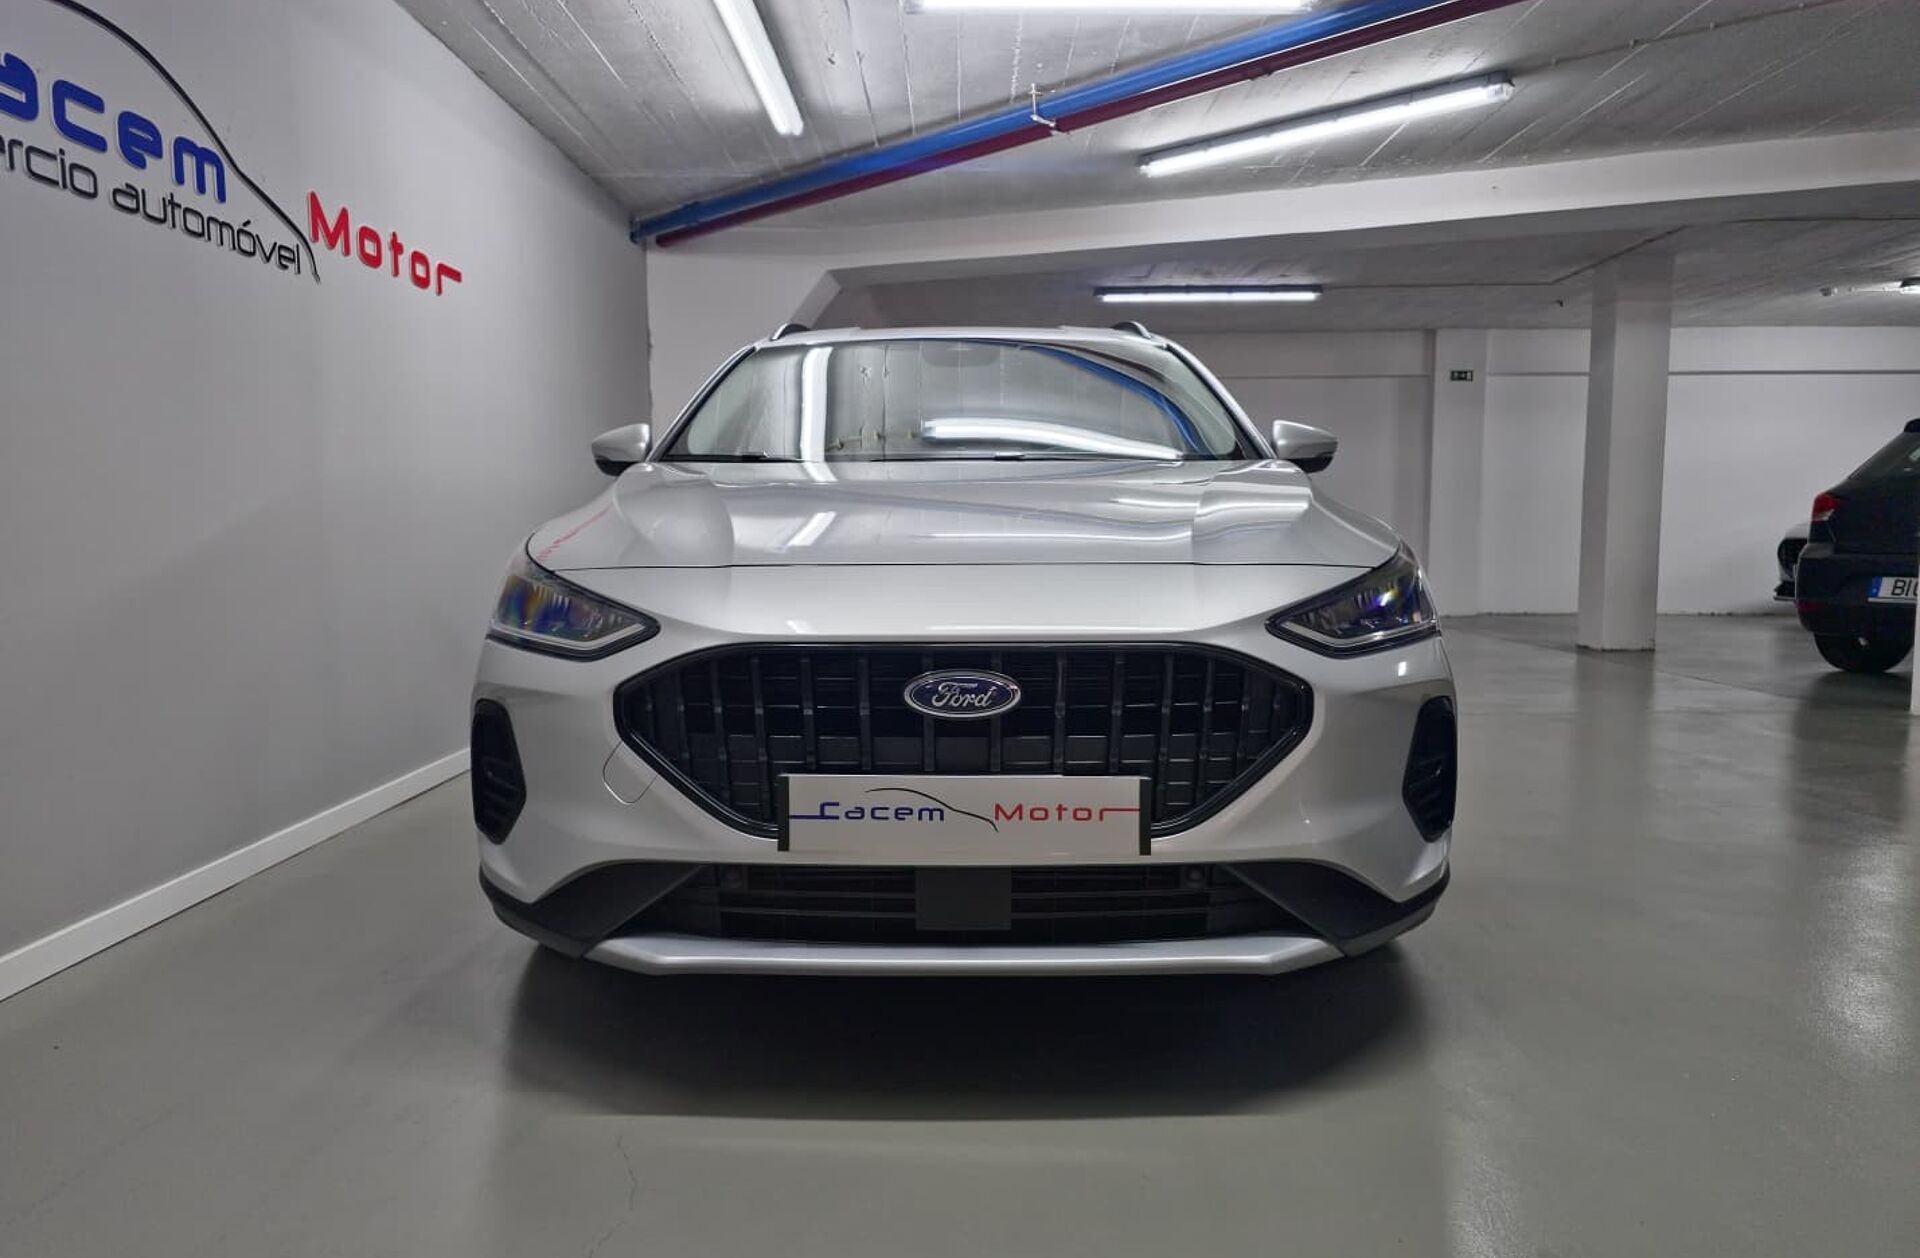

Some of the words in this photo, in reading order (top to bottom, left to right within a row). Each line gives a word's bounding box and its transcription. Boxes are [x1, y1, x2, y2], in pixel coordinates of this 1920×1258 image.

[0, 135, 99, 199] rcio
[111, 182, 302, 275] automóvel
[307, 191, 463, 296] Motor
[931, 681, 996, 708] Ford
[789, 801, 946, 823] Cacem
[993, 802, 1141, 823] Motor
